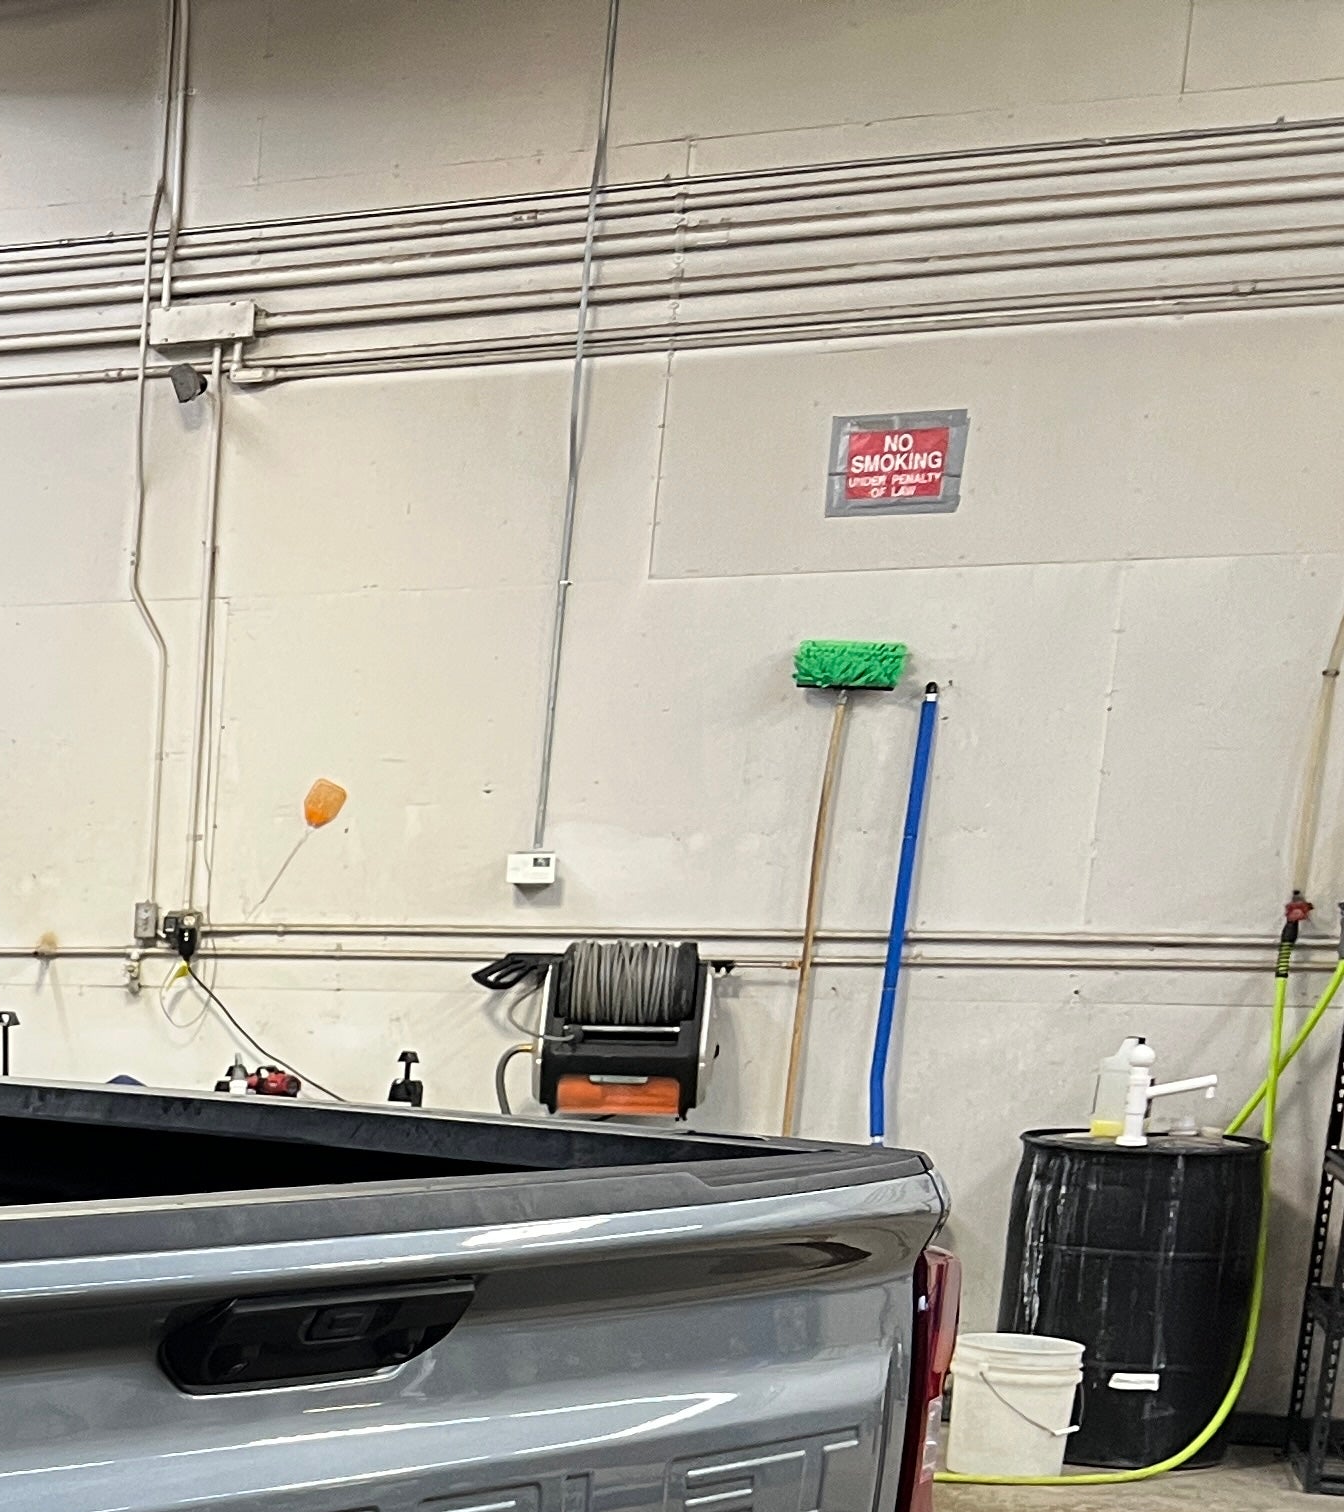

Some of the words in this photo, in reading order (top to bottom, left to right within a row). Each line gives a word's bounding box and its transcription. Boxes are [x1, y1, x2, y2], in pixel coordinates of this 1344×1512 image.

[884, 433, 914, 452] NO
[851, 451, 943, 473] SMOKING
[848, 475, 887, 488] UNDER
[891, 472, 942, 485] PENALTY
[870, 487, 887, 498] OF
[890, 486, 917, 497] LAW
